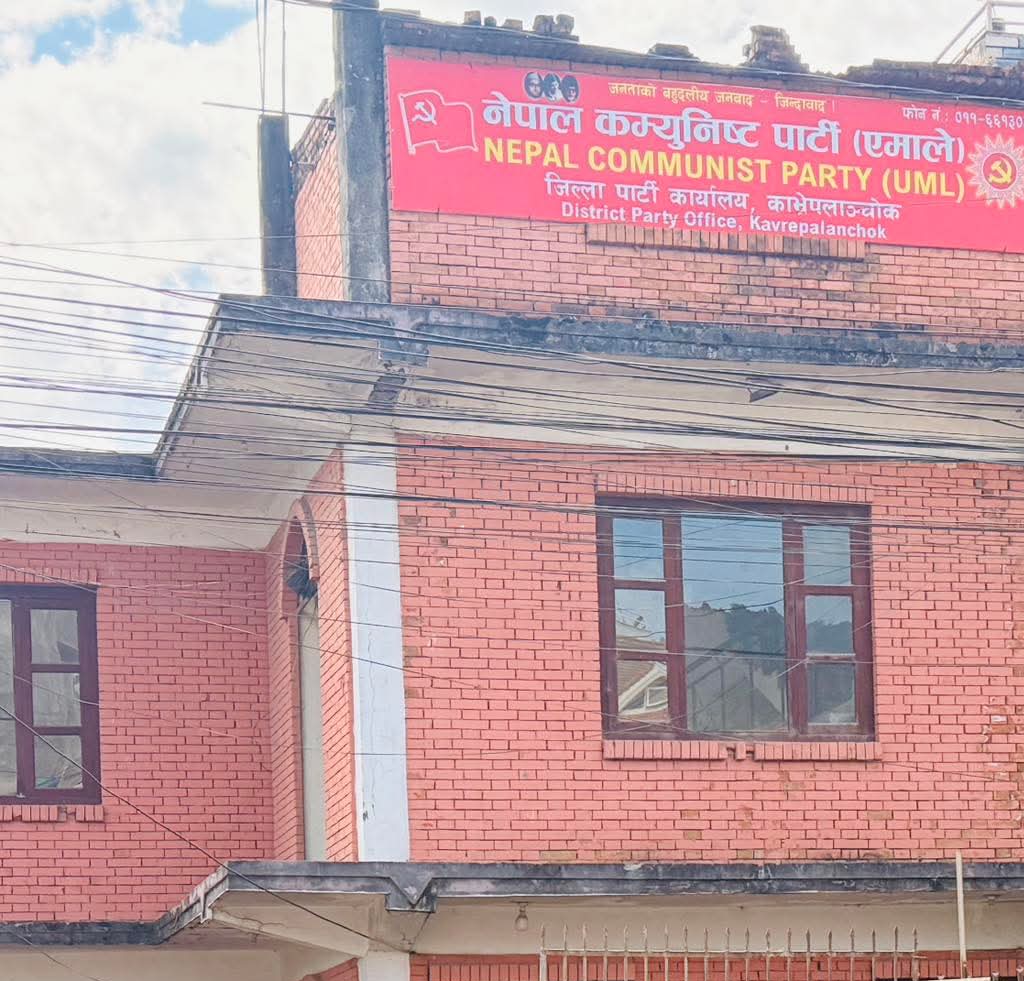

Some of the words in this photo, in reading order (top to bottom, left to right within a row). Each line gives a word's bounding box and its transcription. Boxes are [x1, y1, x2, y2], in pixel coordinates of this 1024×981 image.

[481, 91, 584, 134] नेपाल
[595, 107, 761, 149] कम्युनिष्ट
[772, 119, 841, 155] पार्टी
[853, 128, 965, 164] (एमाले)
[902, 104, 927, 120] फोन
[484, 137, 579, 169] NEPAL
[588, 146, 771, 184] COMMUNIST
[782, 161, 873, 192] PARTY
[882, 168, 965, 204] (UML)
[544, 172, 606, 200] जिल्ला
[615, 180, 659, 203] पार्टी
[562, 202, 626, 222] District
[632, 207, 678, 228] Party
[684, 211, 742, 231] Office,
[750, 215, 887, 239] Kavrepalanchok
